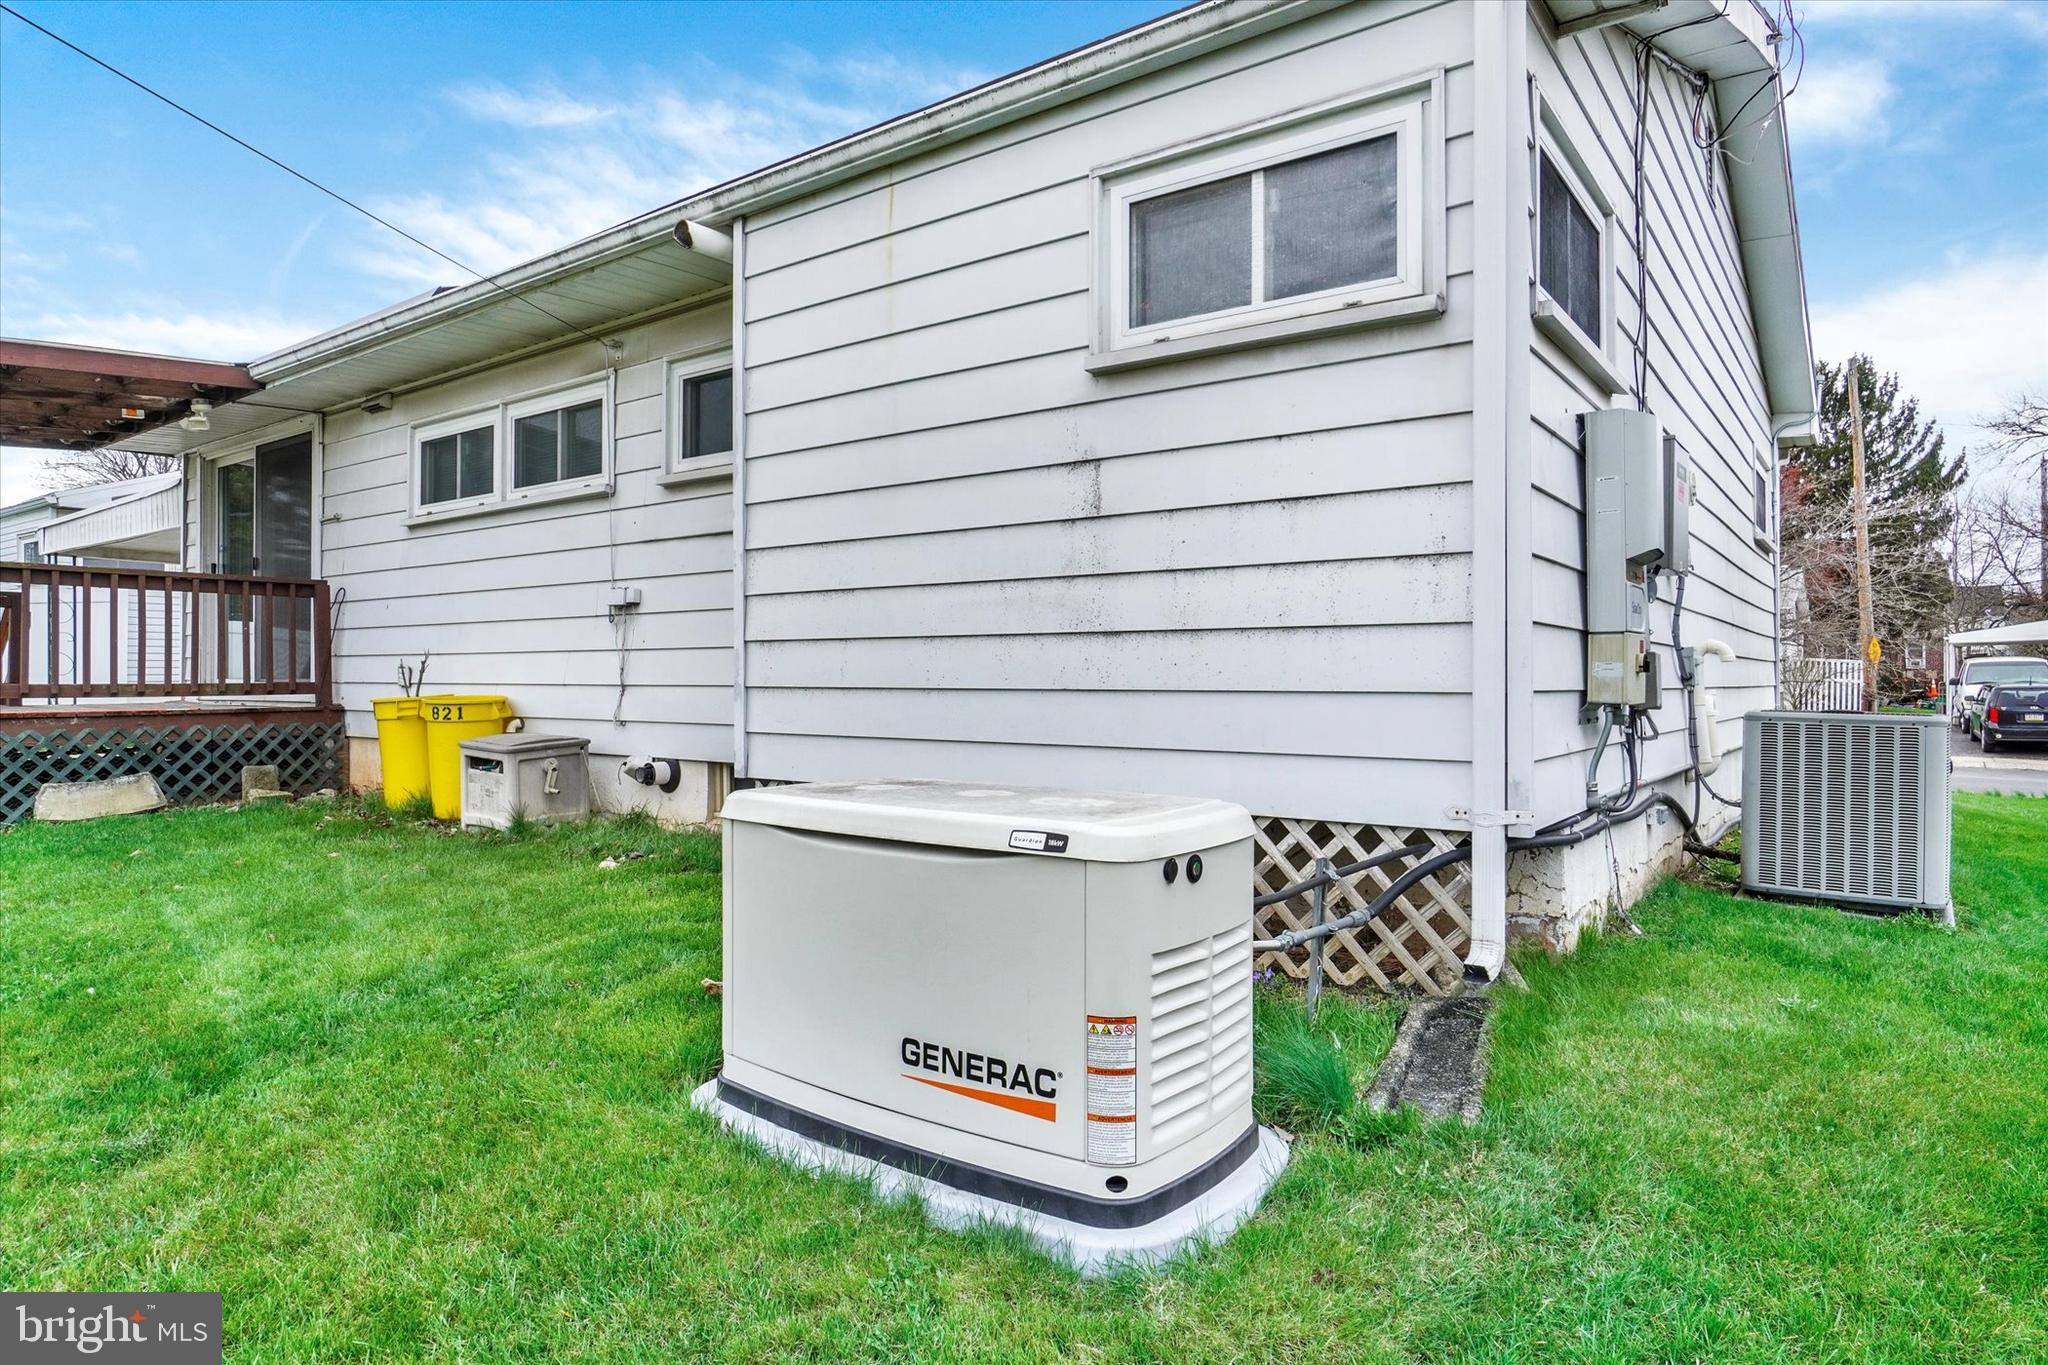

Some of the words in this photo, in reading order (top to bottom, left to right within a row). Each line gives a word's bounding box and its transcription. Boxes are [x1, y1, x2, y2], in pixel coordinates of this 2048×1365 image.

[432, 706, 463, 720] 821
[1013, 836, 1043, 844] Guardian
[901, 1037, 1056, 1099] GENERAC
